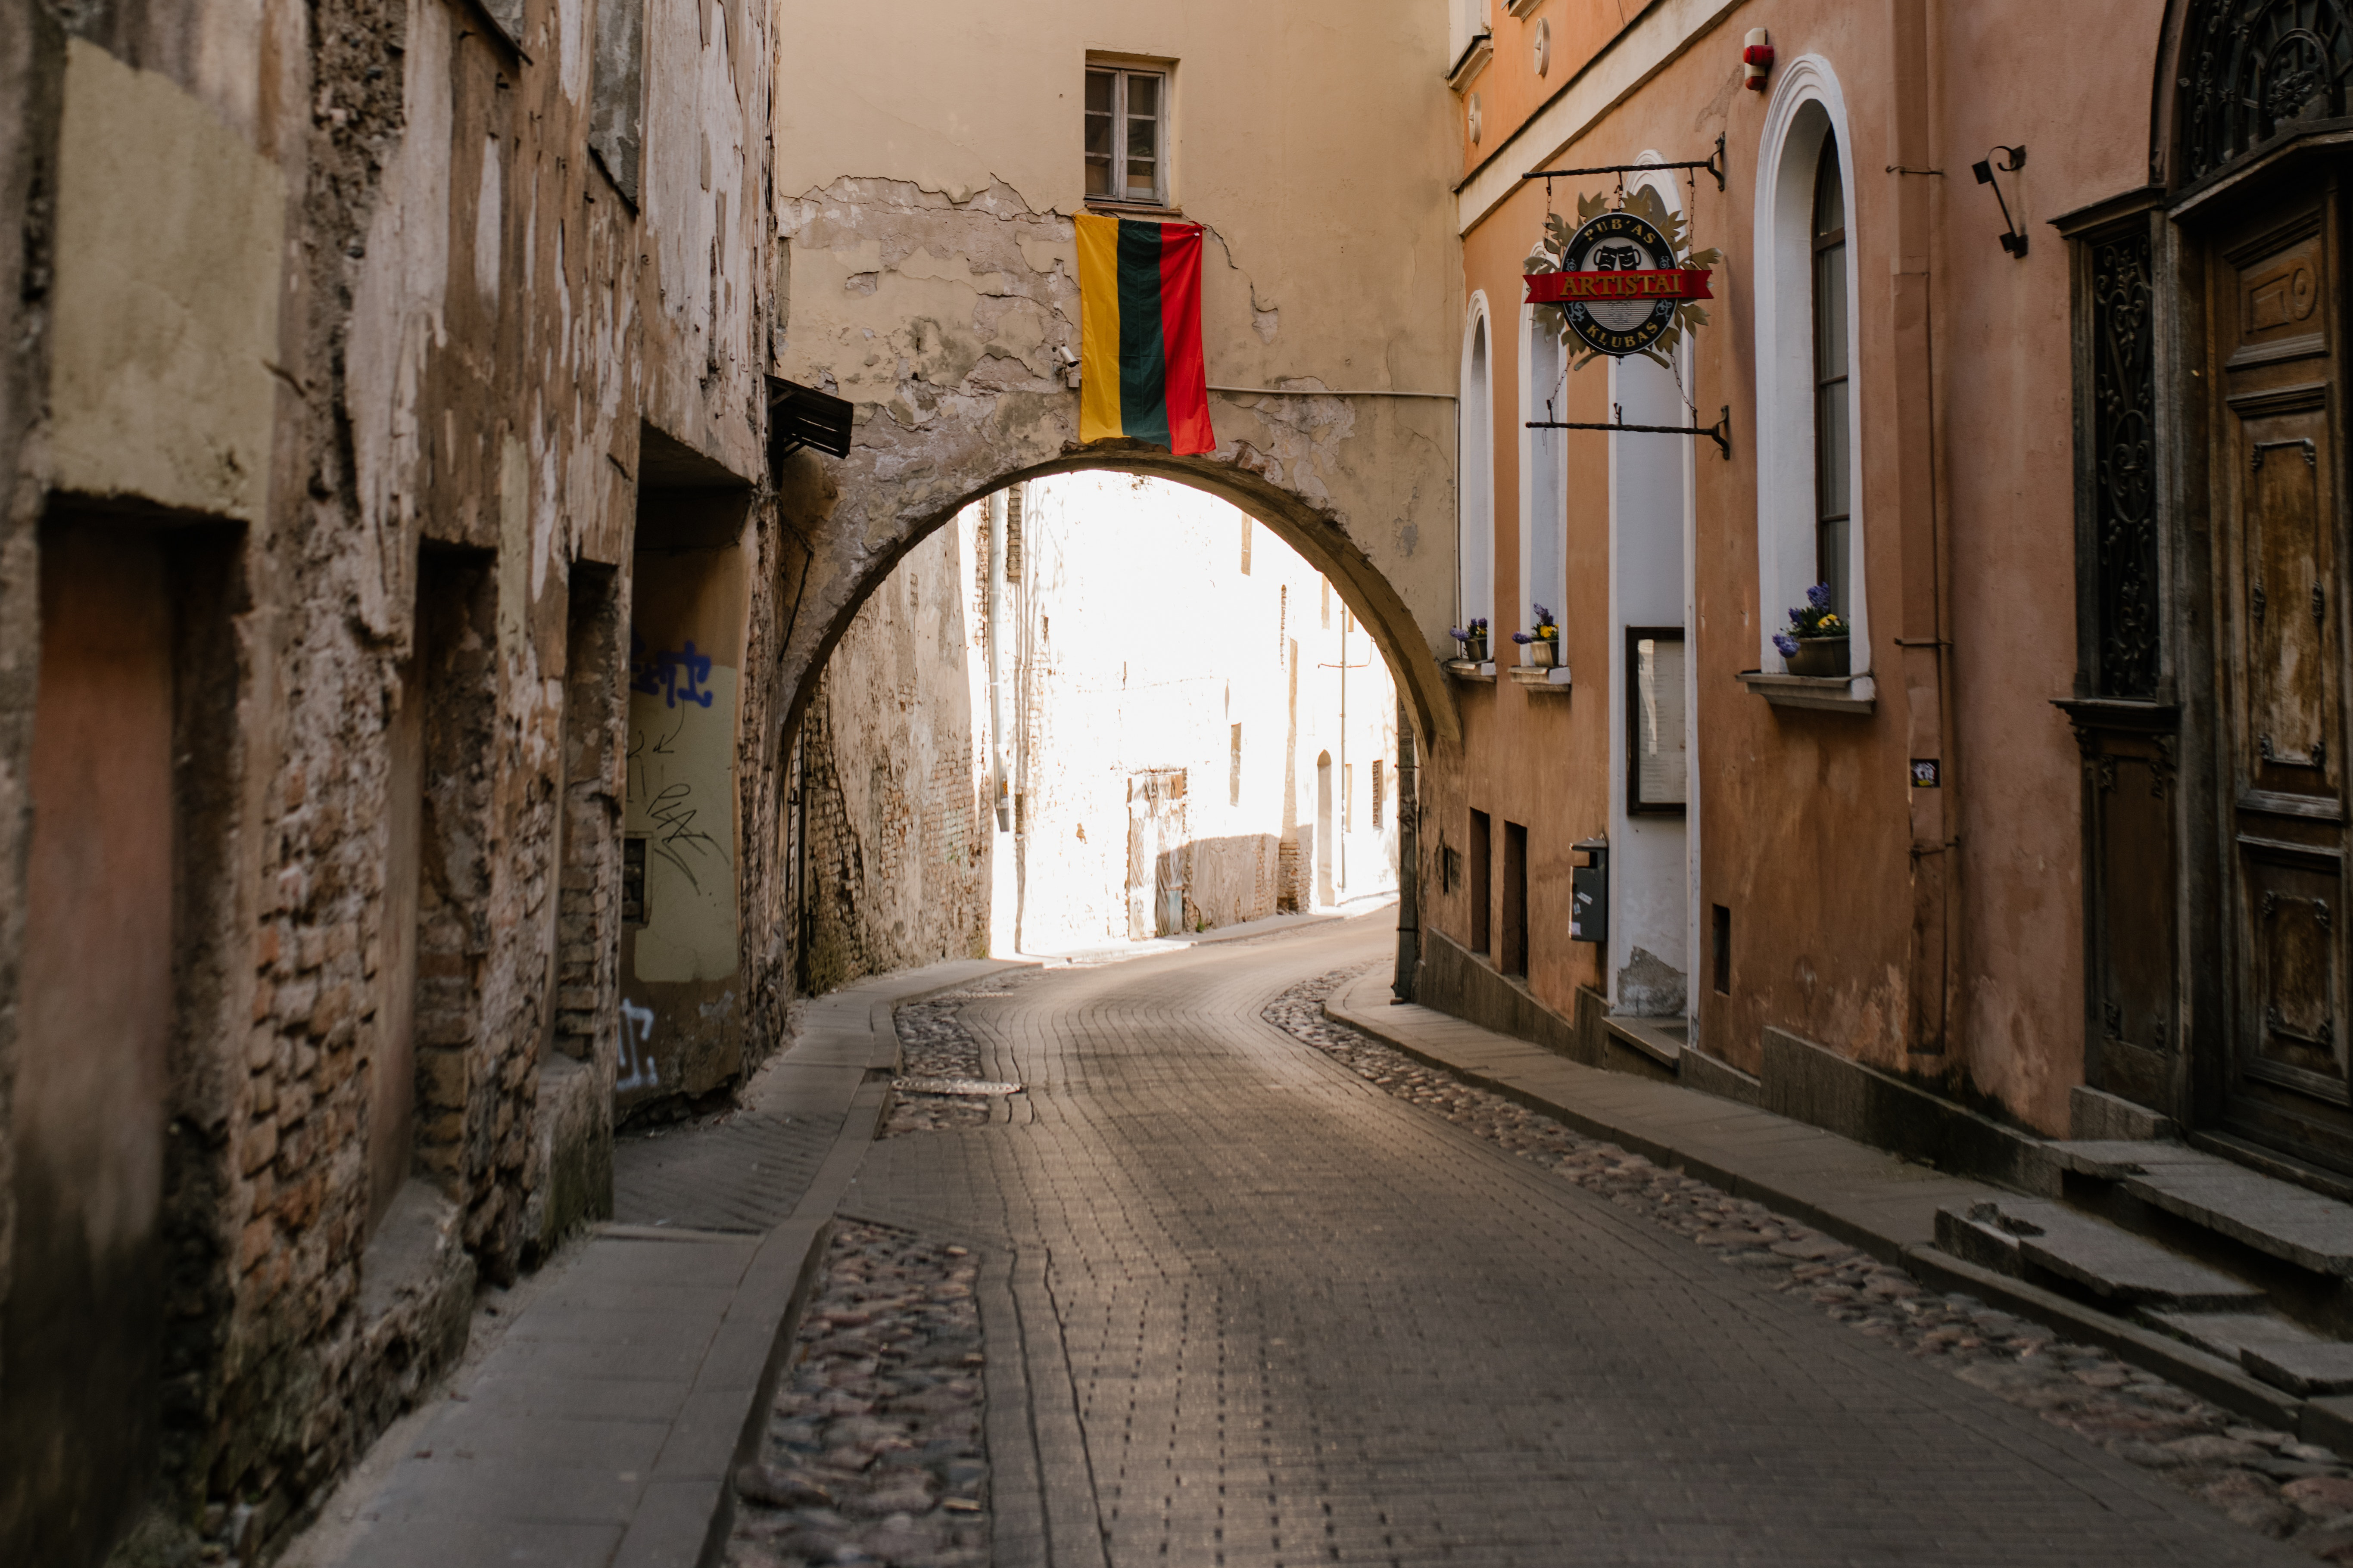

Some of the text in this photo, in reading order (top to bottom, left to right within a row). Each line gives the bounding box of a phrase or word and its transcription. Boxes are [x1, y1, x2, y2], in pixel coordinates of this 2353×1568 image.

[1584, 219, 1656, 244] PUB'AS
[1560, 273, 1682, 297] ARTISTAI
[1586, 322, 1658, 347] KLUBAS
